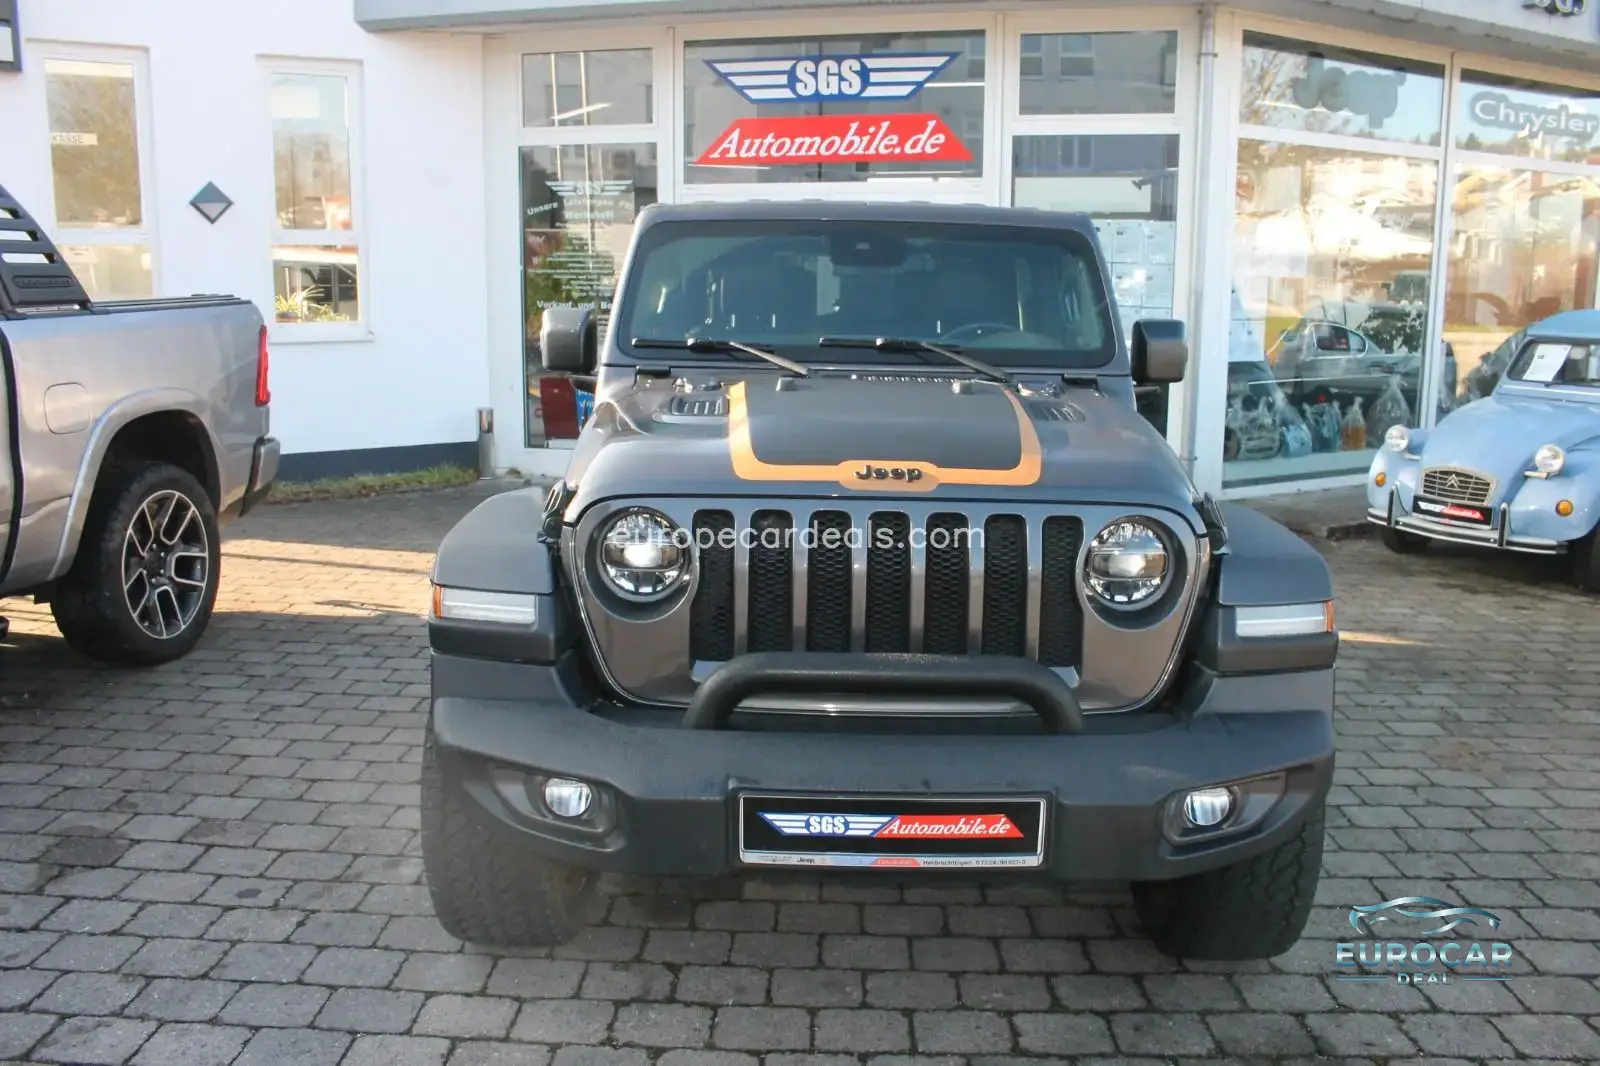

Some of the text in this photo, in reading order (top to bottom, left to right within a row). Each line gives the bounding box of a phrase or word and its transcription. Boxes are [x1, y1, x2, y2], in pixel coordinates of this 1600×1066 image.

[795, 58, 862, 96] SGS
[1474, 98, 1598, 134] Chrysler
[709, 119, 946, 159] Automobile.de
[526, 201, 559, 216] Unsere
[853, 464, 923, 483] Jeep
[809, 815, 1011, 835] SGS Automobile.de
